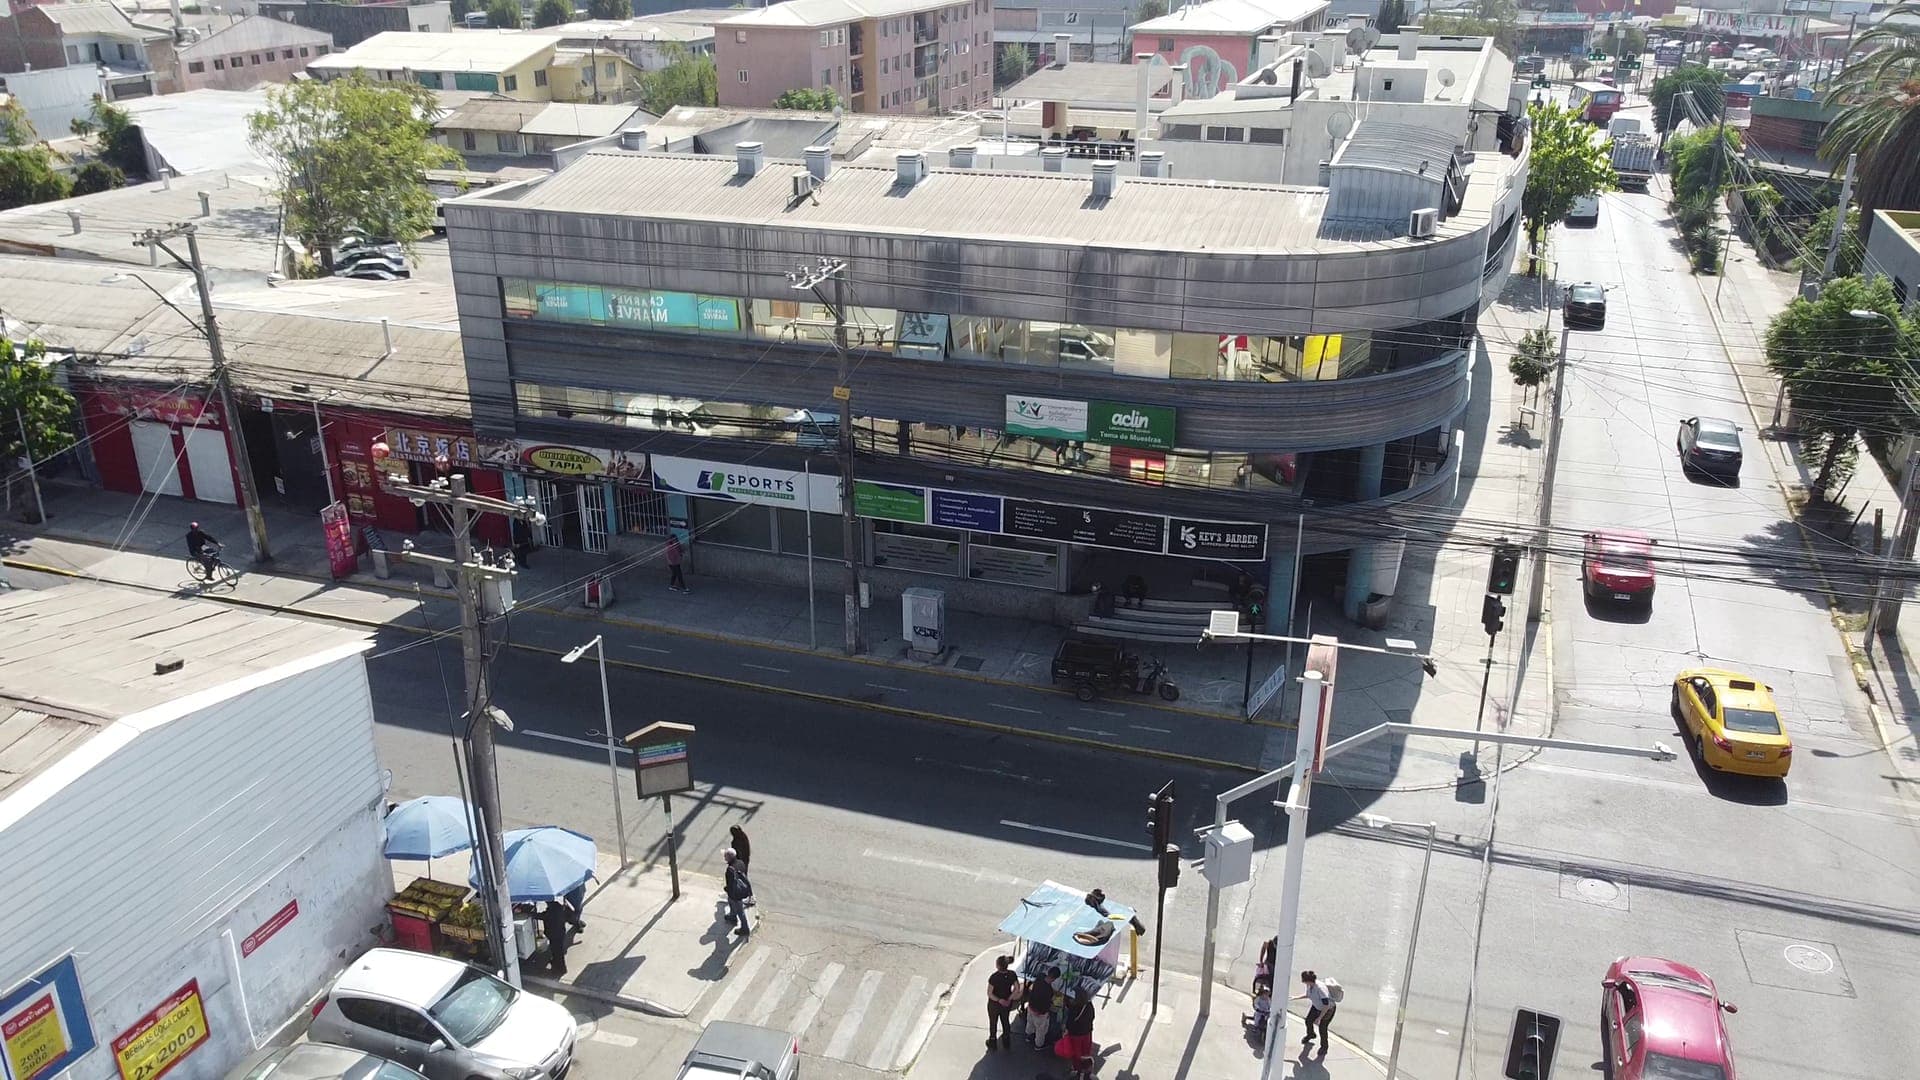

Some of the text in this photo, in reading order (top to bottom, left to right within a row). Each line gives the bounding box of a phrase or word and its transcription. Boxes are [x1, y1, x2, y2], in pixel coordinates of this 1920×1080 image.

[1111, 409, 1149, 429] aclin
[1130, 434, 1162, 443] Muestras
[549, 460, 583, 471] TAPIA
[727, 474, 794, 492] SPORTS
[124, 1035, 153, 1060] BEBIDAS
